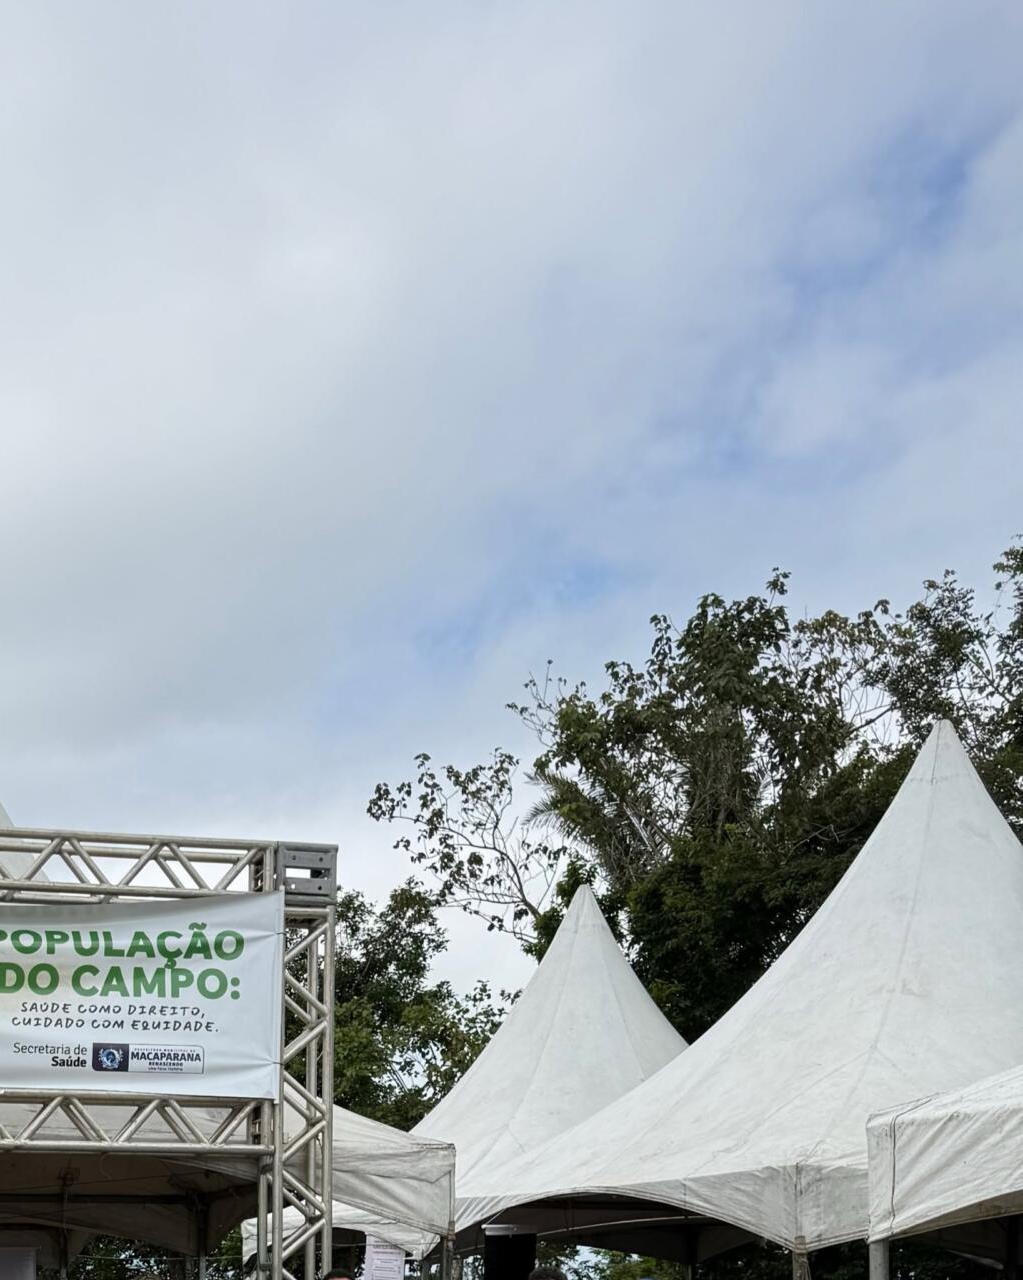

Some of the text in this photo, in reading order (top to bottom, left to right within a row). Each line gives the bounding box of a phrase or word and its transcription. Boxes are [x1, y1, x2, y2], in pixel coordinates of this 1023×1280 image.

[71, 964, 241, 1000] CAMPO:
[21, 1001, 206, 1018] SAÚDE COMO DIREITO,
[12, 1017, 220, 1033] CUIDADO COM EQUIDADE.
[13, 1042, 88, 1056] Secretaria de
[131, 1051, 202, 1062] MACAPARANA
[51, 1056, 87, 1068] Saúde
